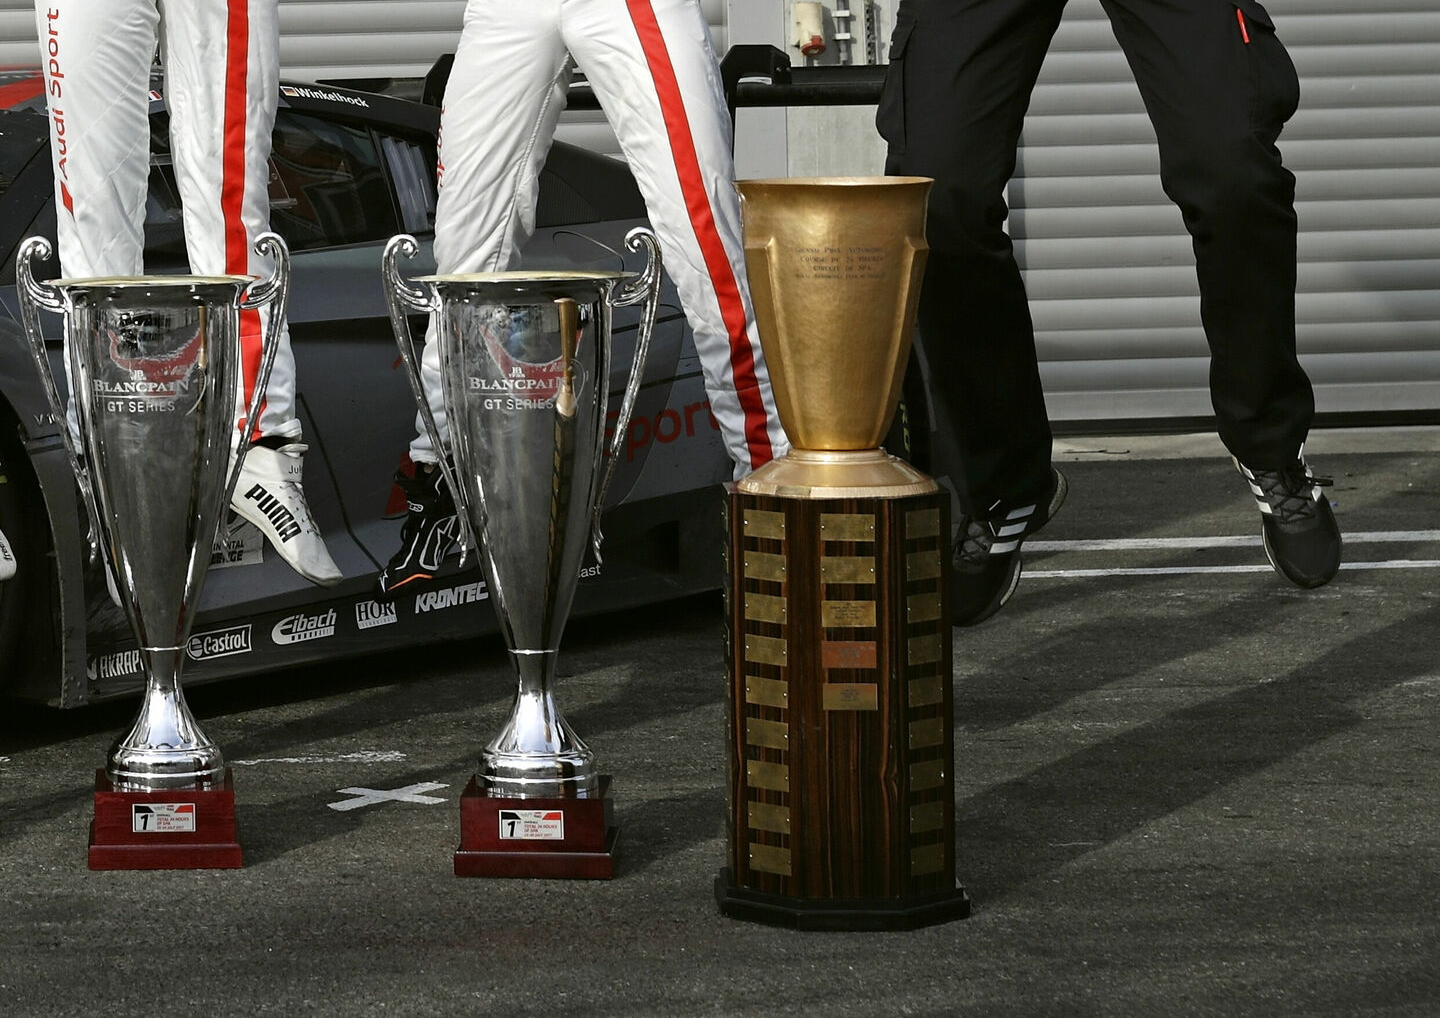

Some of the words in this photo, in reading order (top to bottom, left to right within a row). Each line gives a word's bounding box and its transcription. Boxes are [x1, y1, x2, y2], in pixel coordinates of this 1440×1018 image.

[47, 7, 64, 98] Sport
[295, 87, 370, 109] Winkelhock
[52, 108, 68, 180] Audi
[93, 379, 189, 393] BLANCPAIN
[107, 402, 124, 412] GT
[128, 401, 175, 412] SERIES
[484, 399, 501, 410] GT
[506, 398, 554, 410] SERIES
[244, 483, 302, 543] PUMA
[579, 564, 602, 578] ast
[415, 581, 488, 614] KRONTEC
[271, 608, 337, 645] Eibach
[203, 631, 248, 654] Castrol
[100, 650, 144, 678] AKRAP
